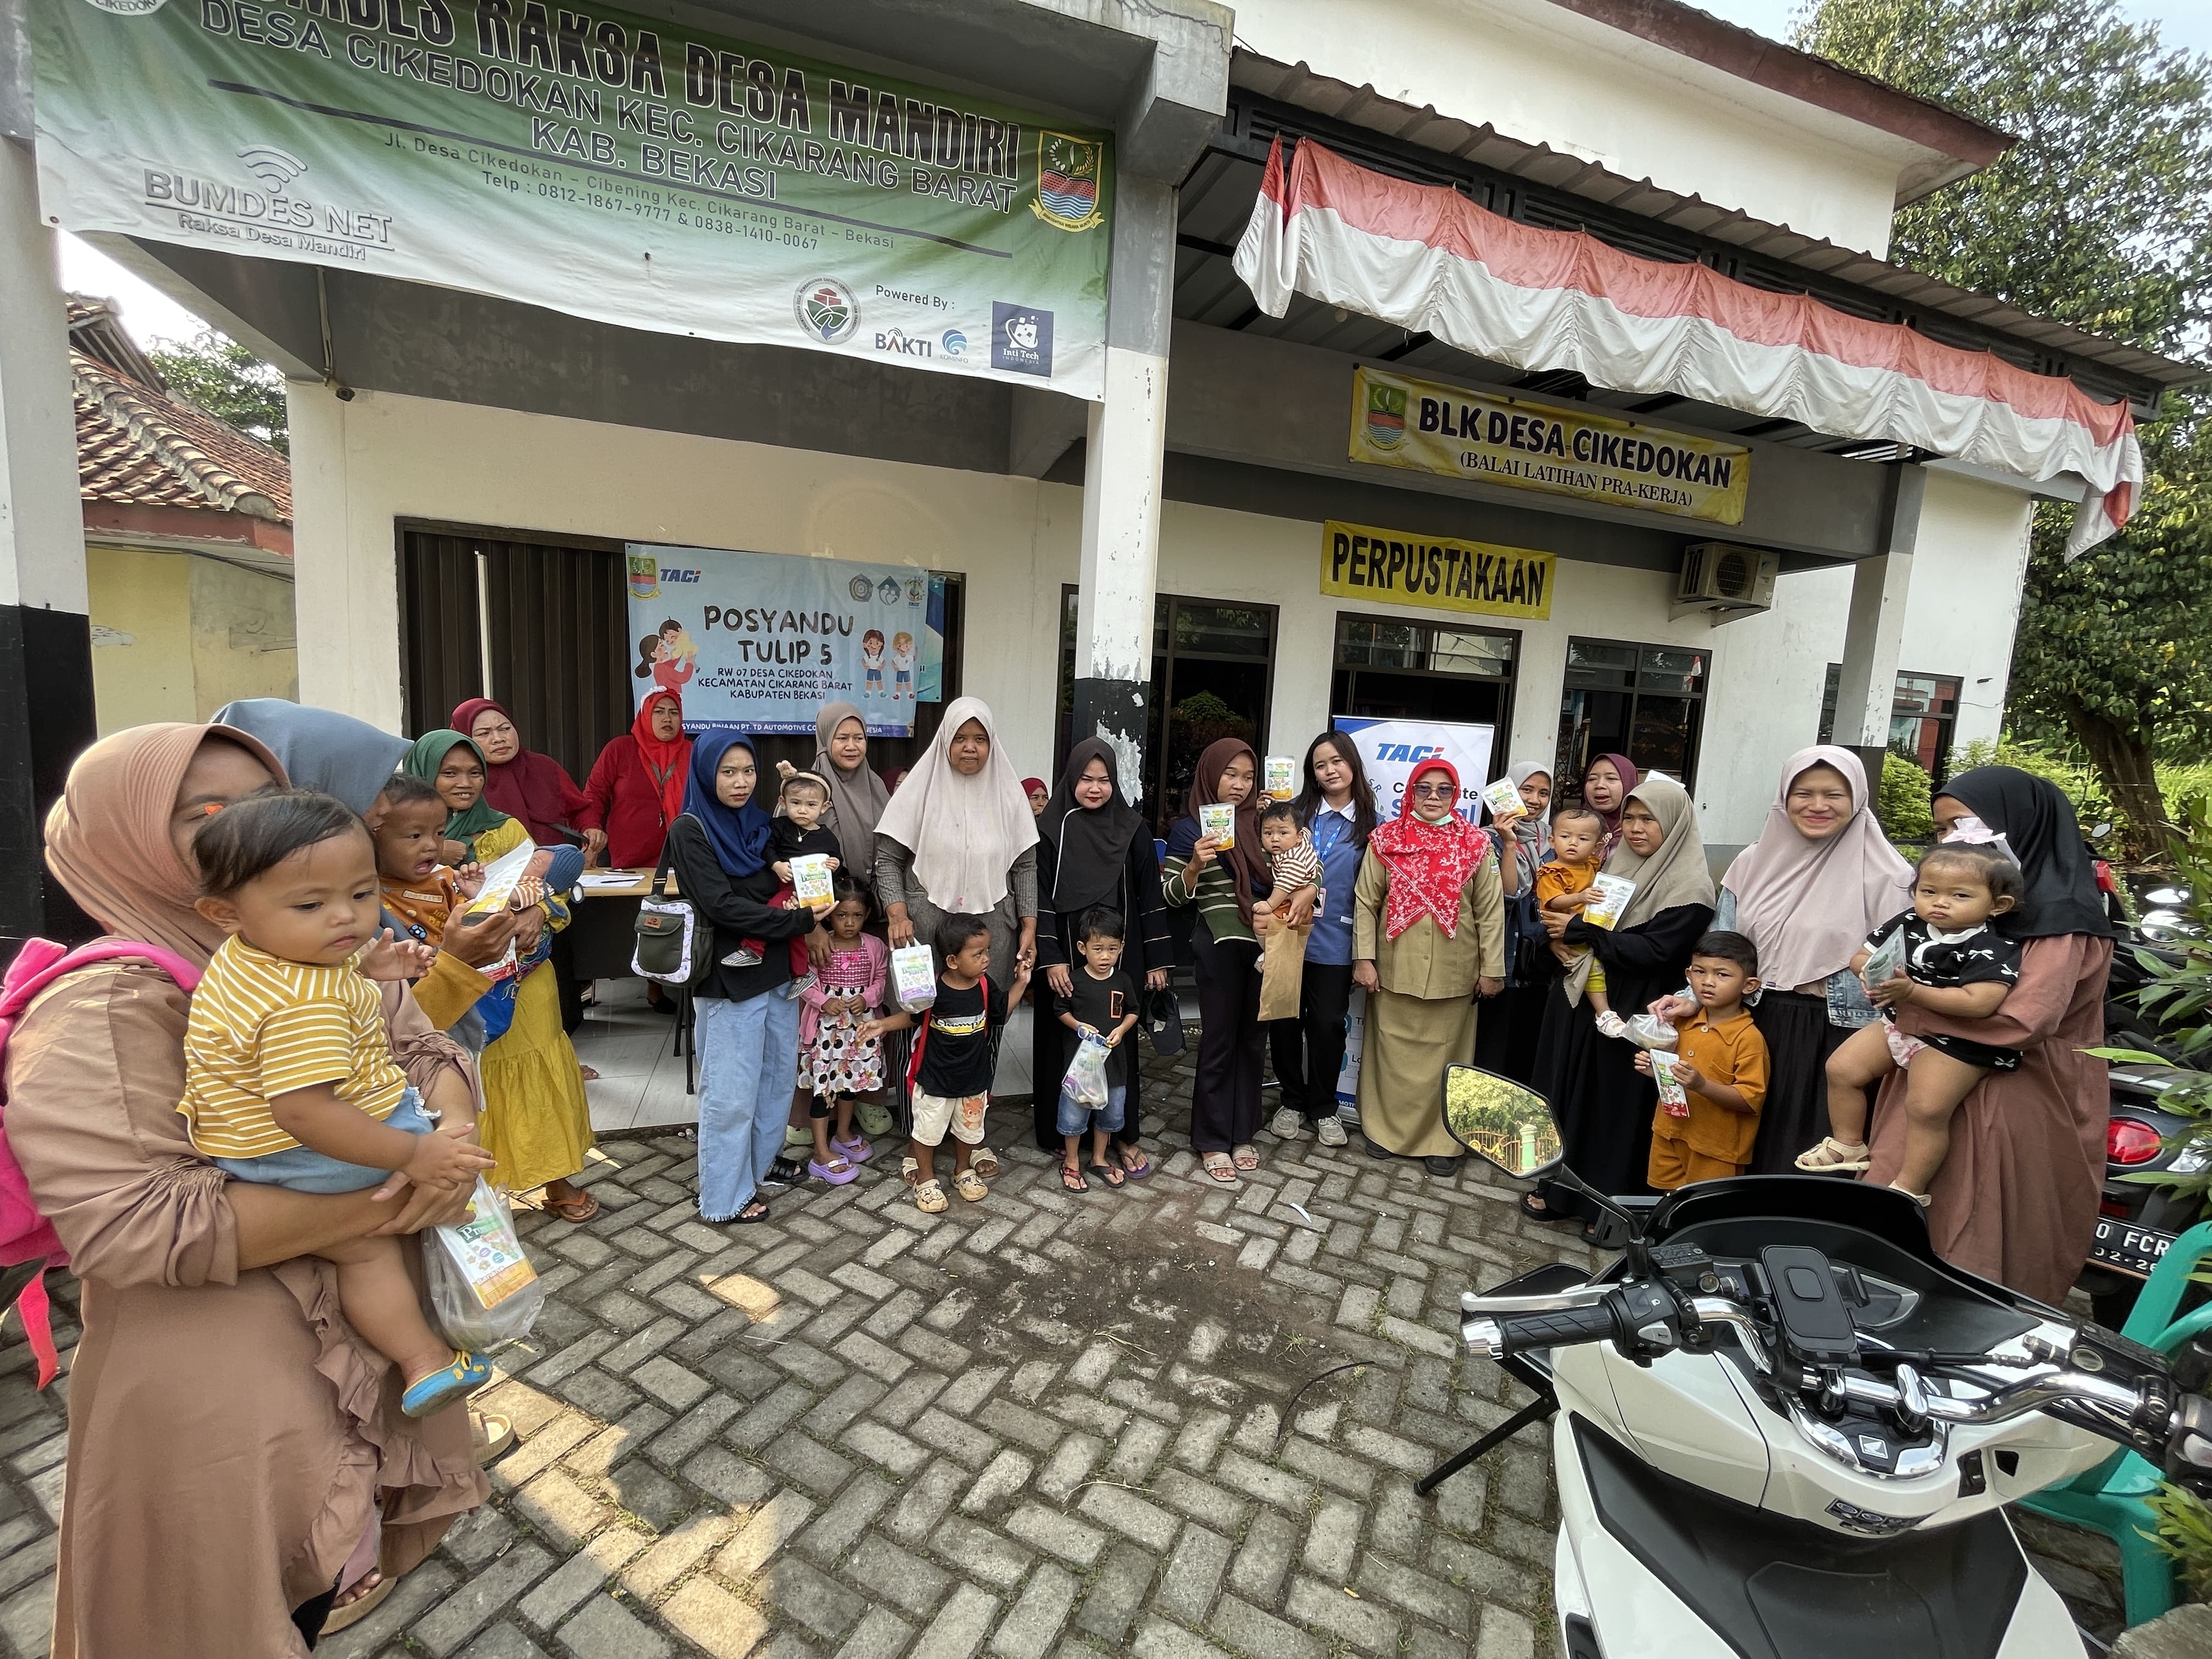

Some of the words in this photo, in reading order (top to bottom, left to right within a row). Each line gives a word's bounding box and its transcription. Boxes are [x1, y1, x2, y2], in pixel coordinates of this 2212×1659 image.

[200, 0, 332, 59] DESA
[346, 33, 602, 125] CIKEDOKAN
[616, 94, 704, 148] KEC.
[715, 119, 900, 190] CIKARANG
[910, 170, 1018, 215] BARAT
[475, 0, 666, 99] RAKSA
[685, 41, 810, 133] DESA
[827, 78, 1020, 181] MANDIRI
[532, 117, 627, 168] KAB.
[641, 143, 777, 200] BEKASI
[144, 168, 314, 227] BUMDES
[325, 205, 393, 243] NET
[385, 132, 406, 149] Jl.
[414, 137, 460, 160] Desa
[469, 150, 563, 182] Cikedokan
[586, 175, 660, 205] Cibening
[667, 192, 701, 211] Kec.
[708, 201, 777, 228] Cikarang
[784, 216, 826, 236] Barat
[845, 229, 895, 249] Bekasi
[482, 170, 520, 194] Telp
[538, 182, 671, 222] 0812-1867-9777
[677, 212, 689, 225] &
[695, 215, 818, 251] 0838-1410-0067
[178, 212, 240, 238] Raksa
[245, 224, 293, 247] Desa
[298, 235, 366, 261] Mandiri
[876, 285, 929, 306] Powered
[933, 296, 947, 311] By
[875, 330, 932, 357] BAKTI
[940, 354, 969, 364] KOMINFO
[1003, 347, 1019, 357] Inti
[1021, 351, 1040, 360] Tech
[1419, 397, 1481, 442] BLK
[1487, 410, 1565, 458] DESA
[1570, 429, 1733, 490] CIKEDOKAN
[1460, 450, 1520, 477] (BALAI
[1524, 460, 1598, 490] LATIHAN
[1601, 477, 1694, 507] PRA-KERJA)
[1331, 532, 1547, 607] PERPUSTAKAAN
[703, 605, 855, 637] POSYANDU
[738, 640, 811, 665] TULIP
[820, 644, 833, 665] 5
[698, 678, 766, 690] KECAMATAN
[768, 680, 820, 690] CIKARANG
[821, 681, 853, 692] BARAT
[717, 667, 734, 678] RW
[736, 668, 747, 678] 07
[750, 668, 775, 678] DESA
[778, 669, 833, 680] CIKEDOKAN
[730, 691, 791, 701] KABUPATEN
[793, 691, 826, 701] BEKASI
[2123, 1231, 2170, 1256] FCR
